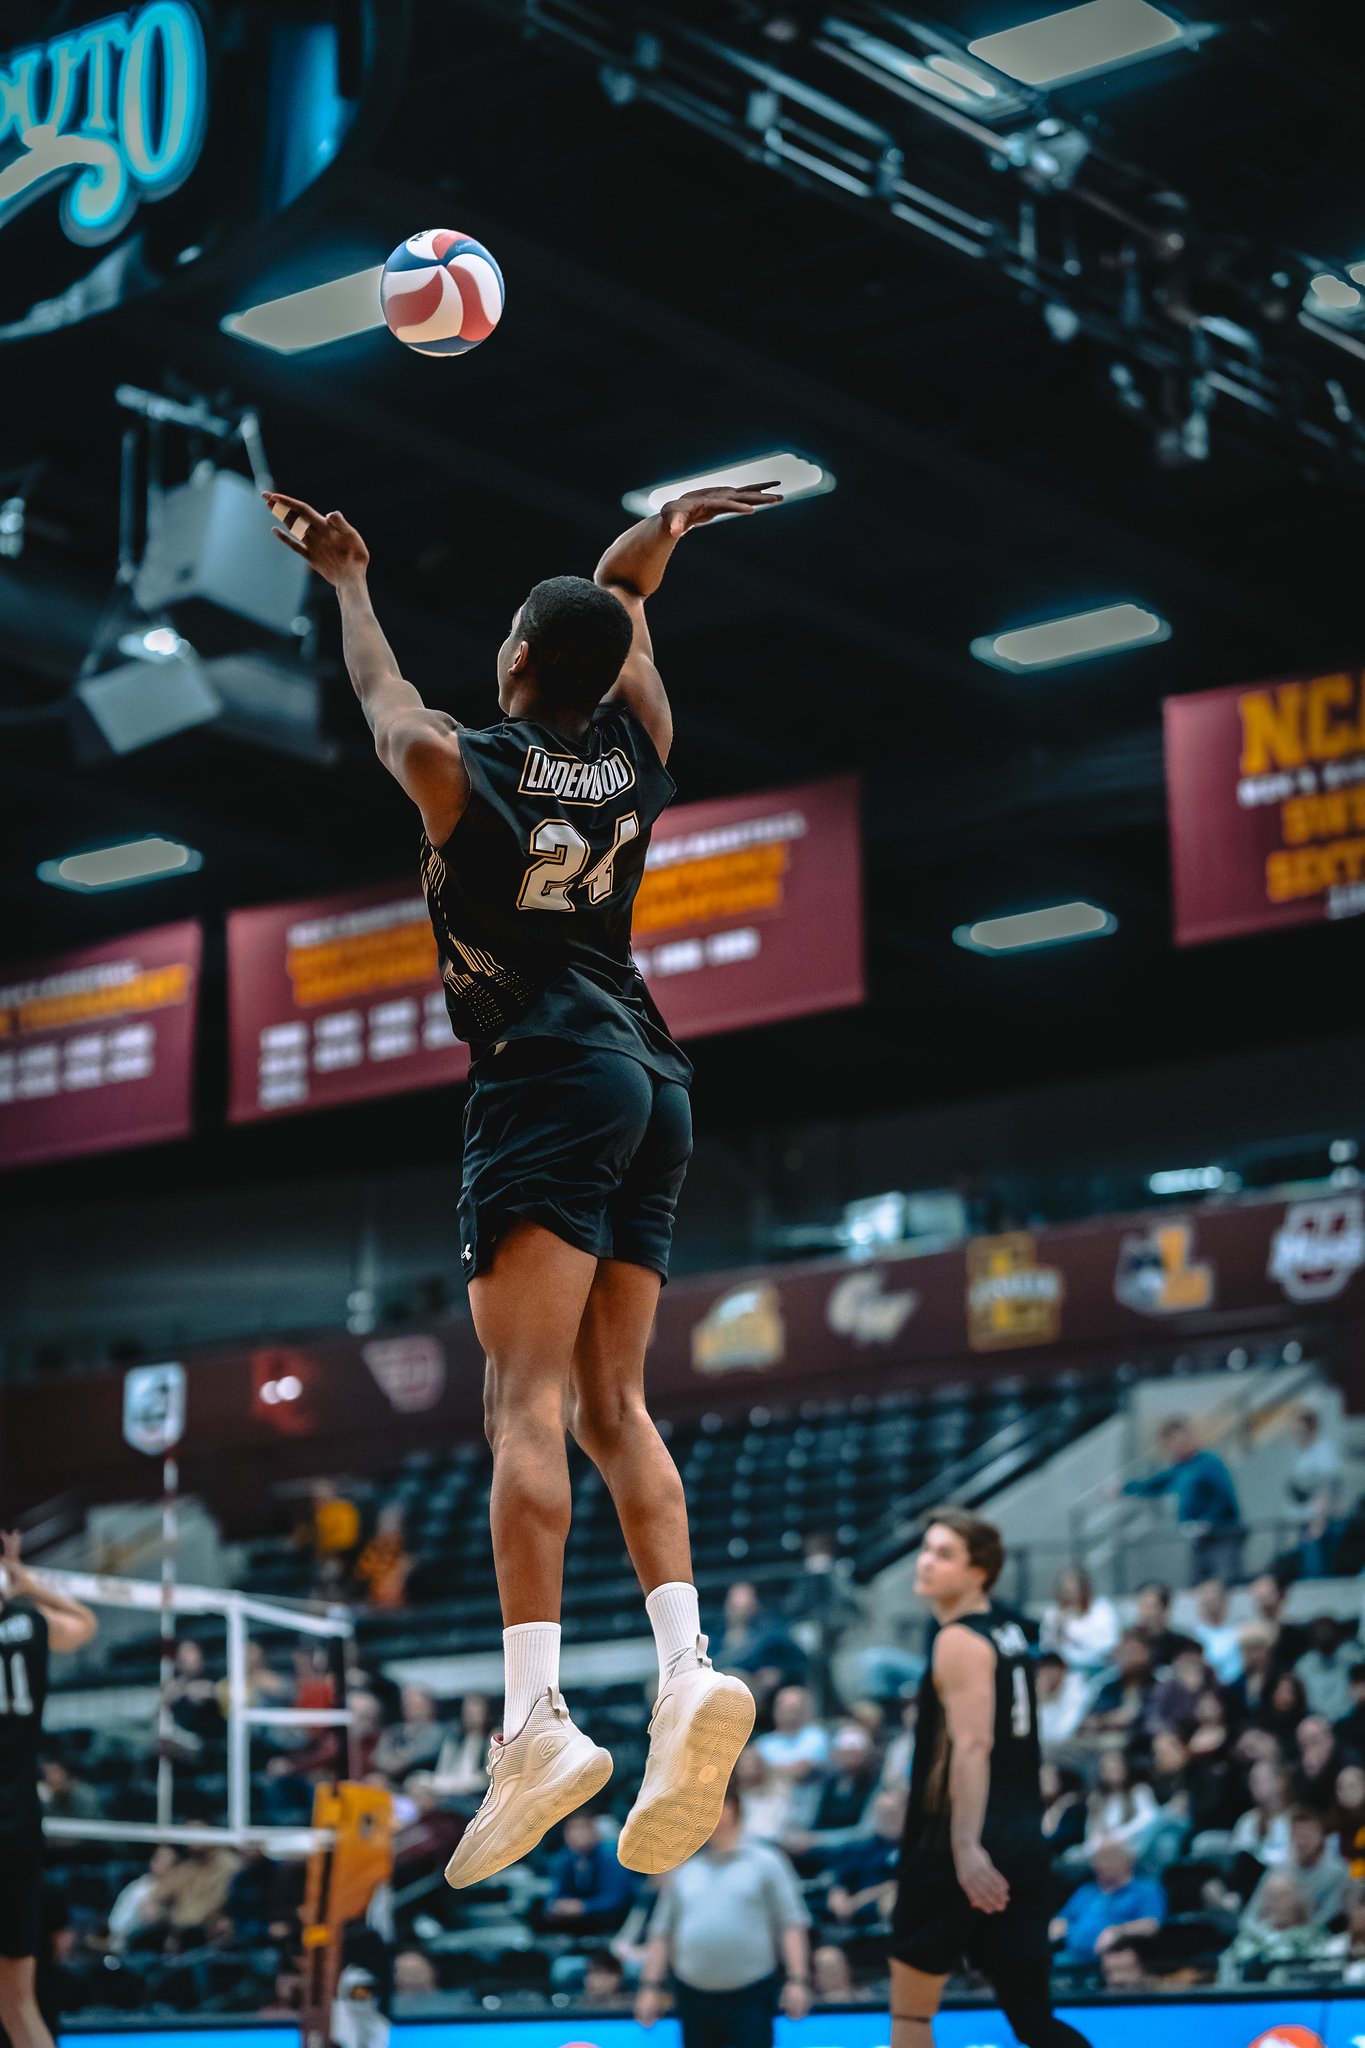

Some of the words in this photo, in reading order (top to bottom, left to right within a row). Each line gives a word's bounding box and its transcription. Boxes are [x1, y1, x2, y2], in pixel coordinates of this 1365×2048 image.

[1238, 672, 1365, 777] NC
[526, 752, 629, 801] LINDENOOD
[516, 811, 639, 913] 24
